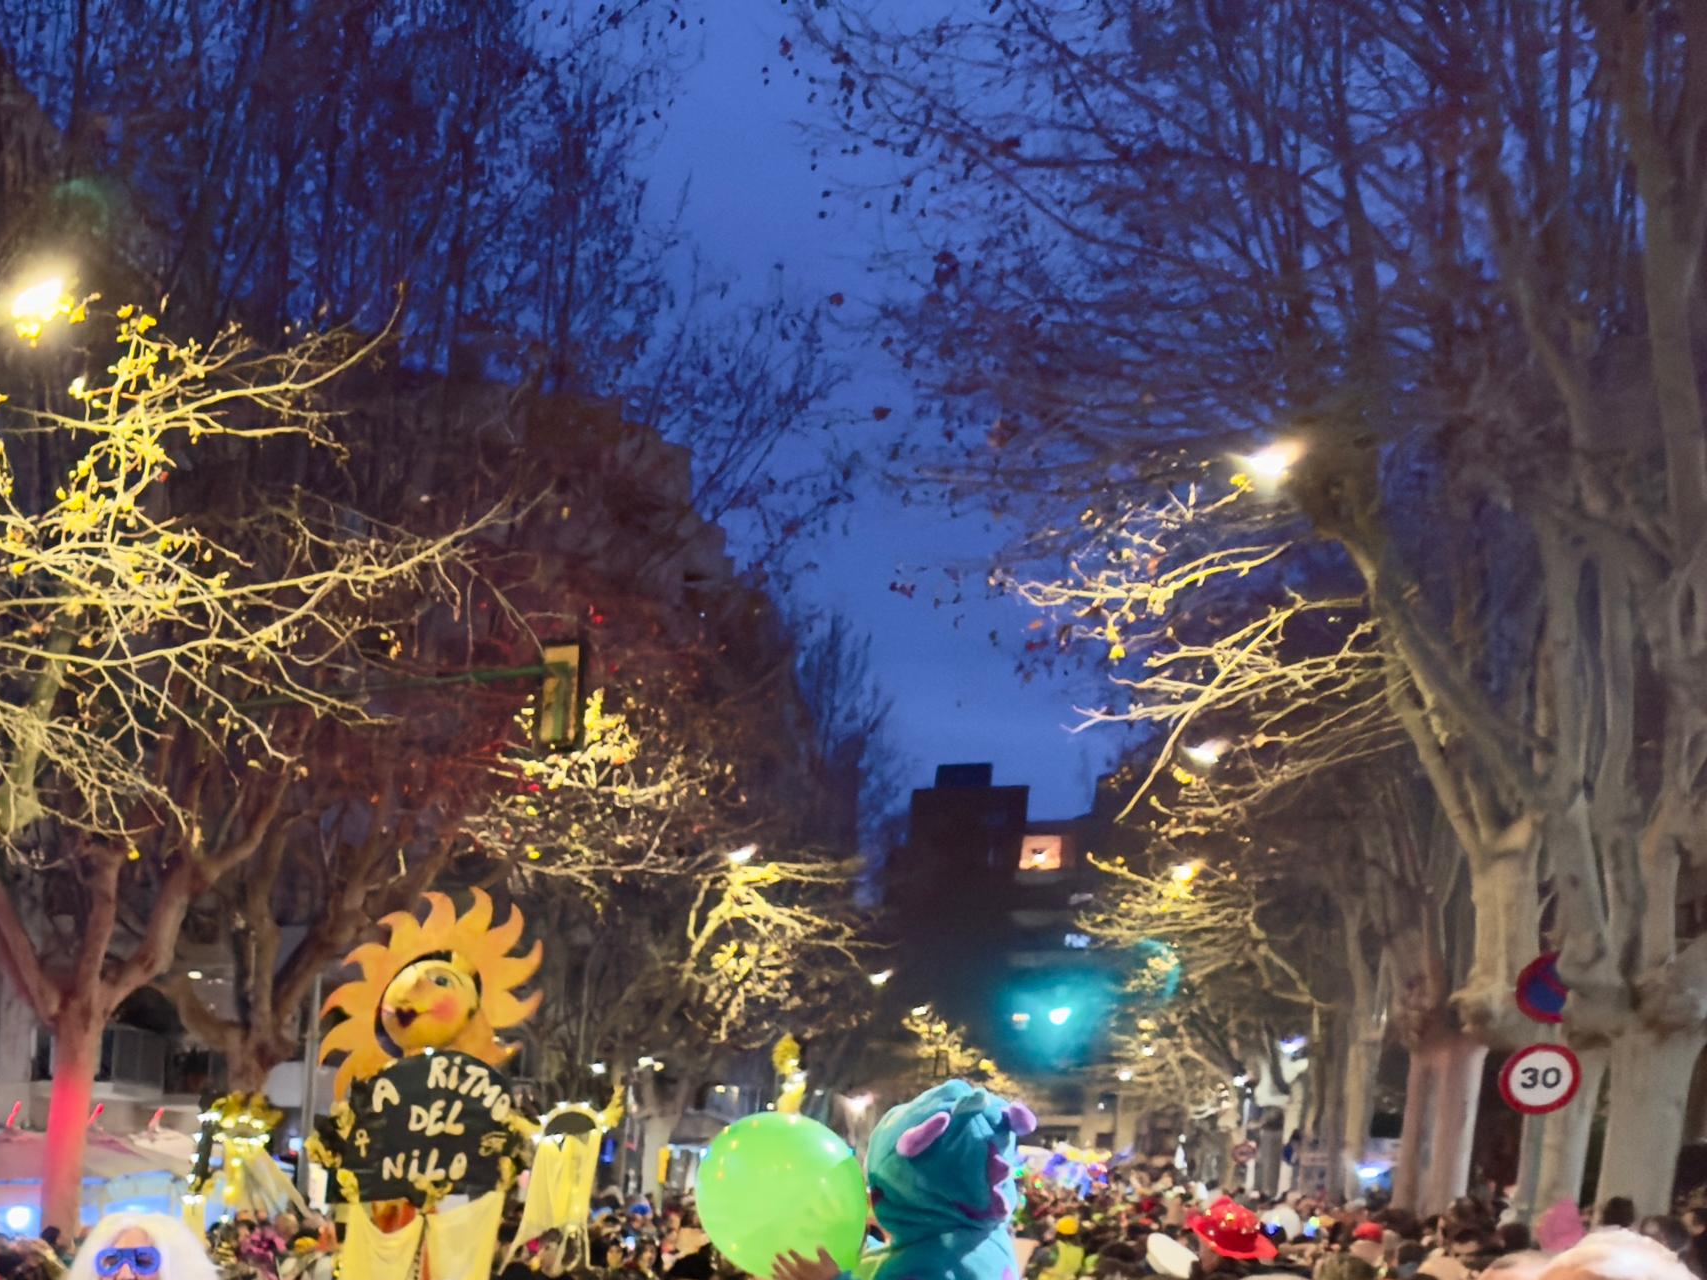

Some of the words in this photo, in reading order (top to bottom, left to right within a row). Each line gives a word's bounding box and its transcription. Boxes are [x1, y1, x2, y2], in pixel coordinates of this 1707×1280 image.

[372, 1078, 400, 1113] A
[1521, 1067, 1562, 1089] 30
[408, 1100, 465, 1137] DEL
